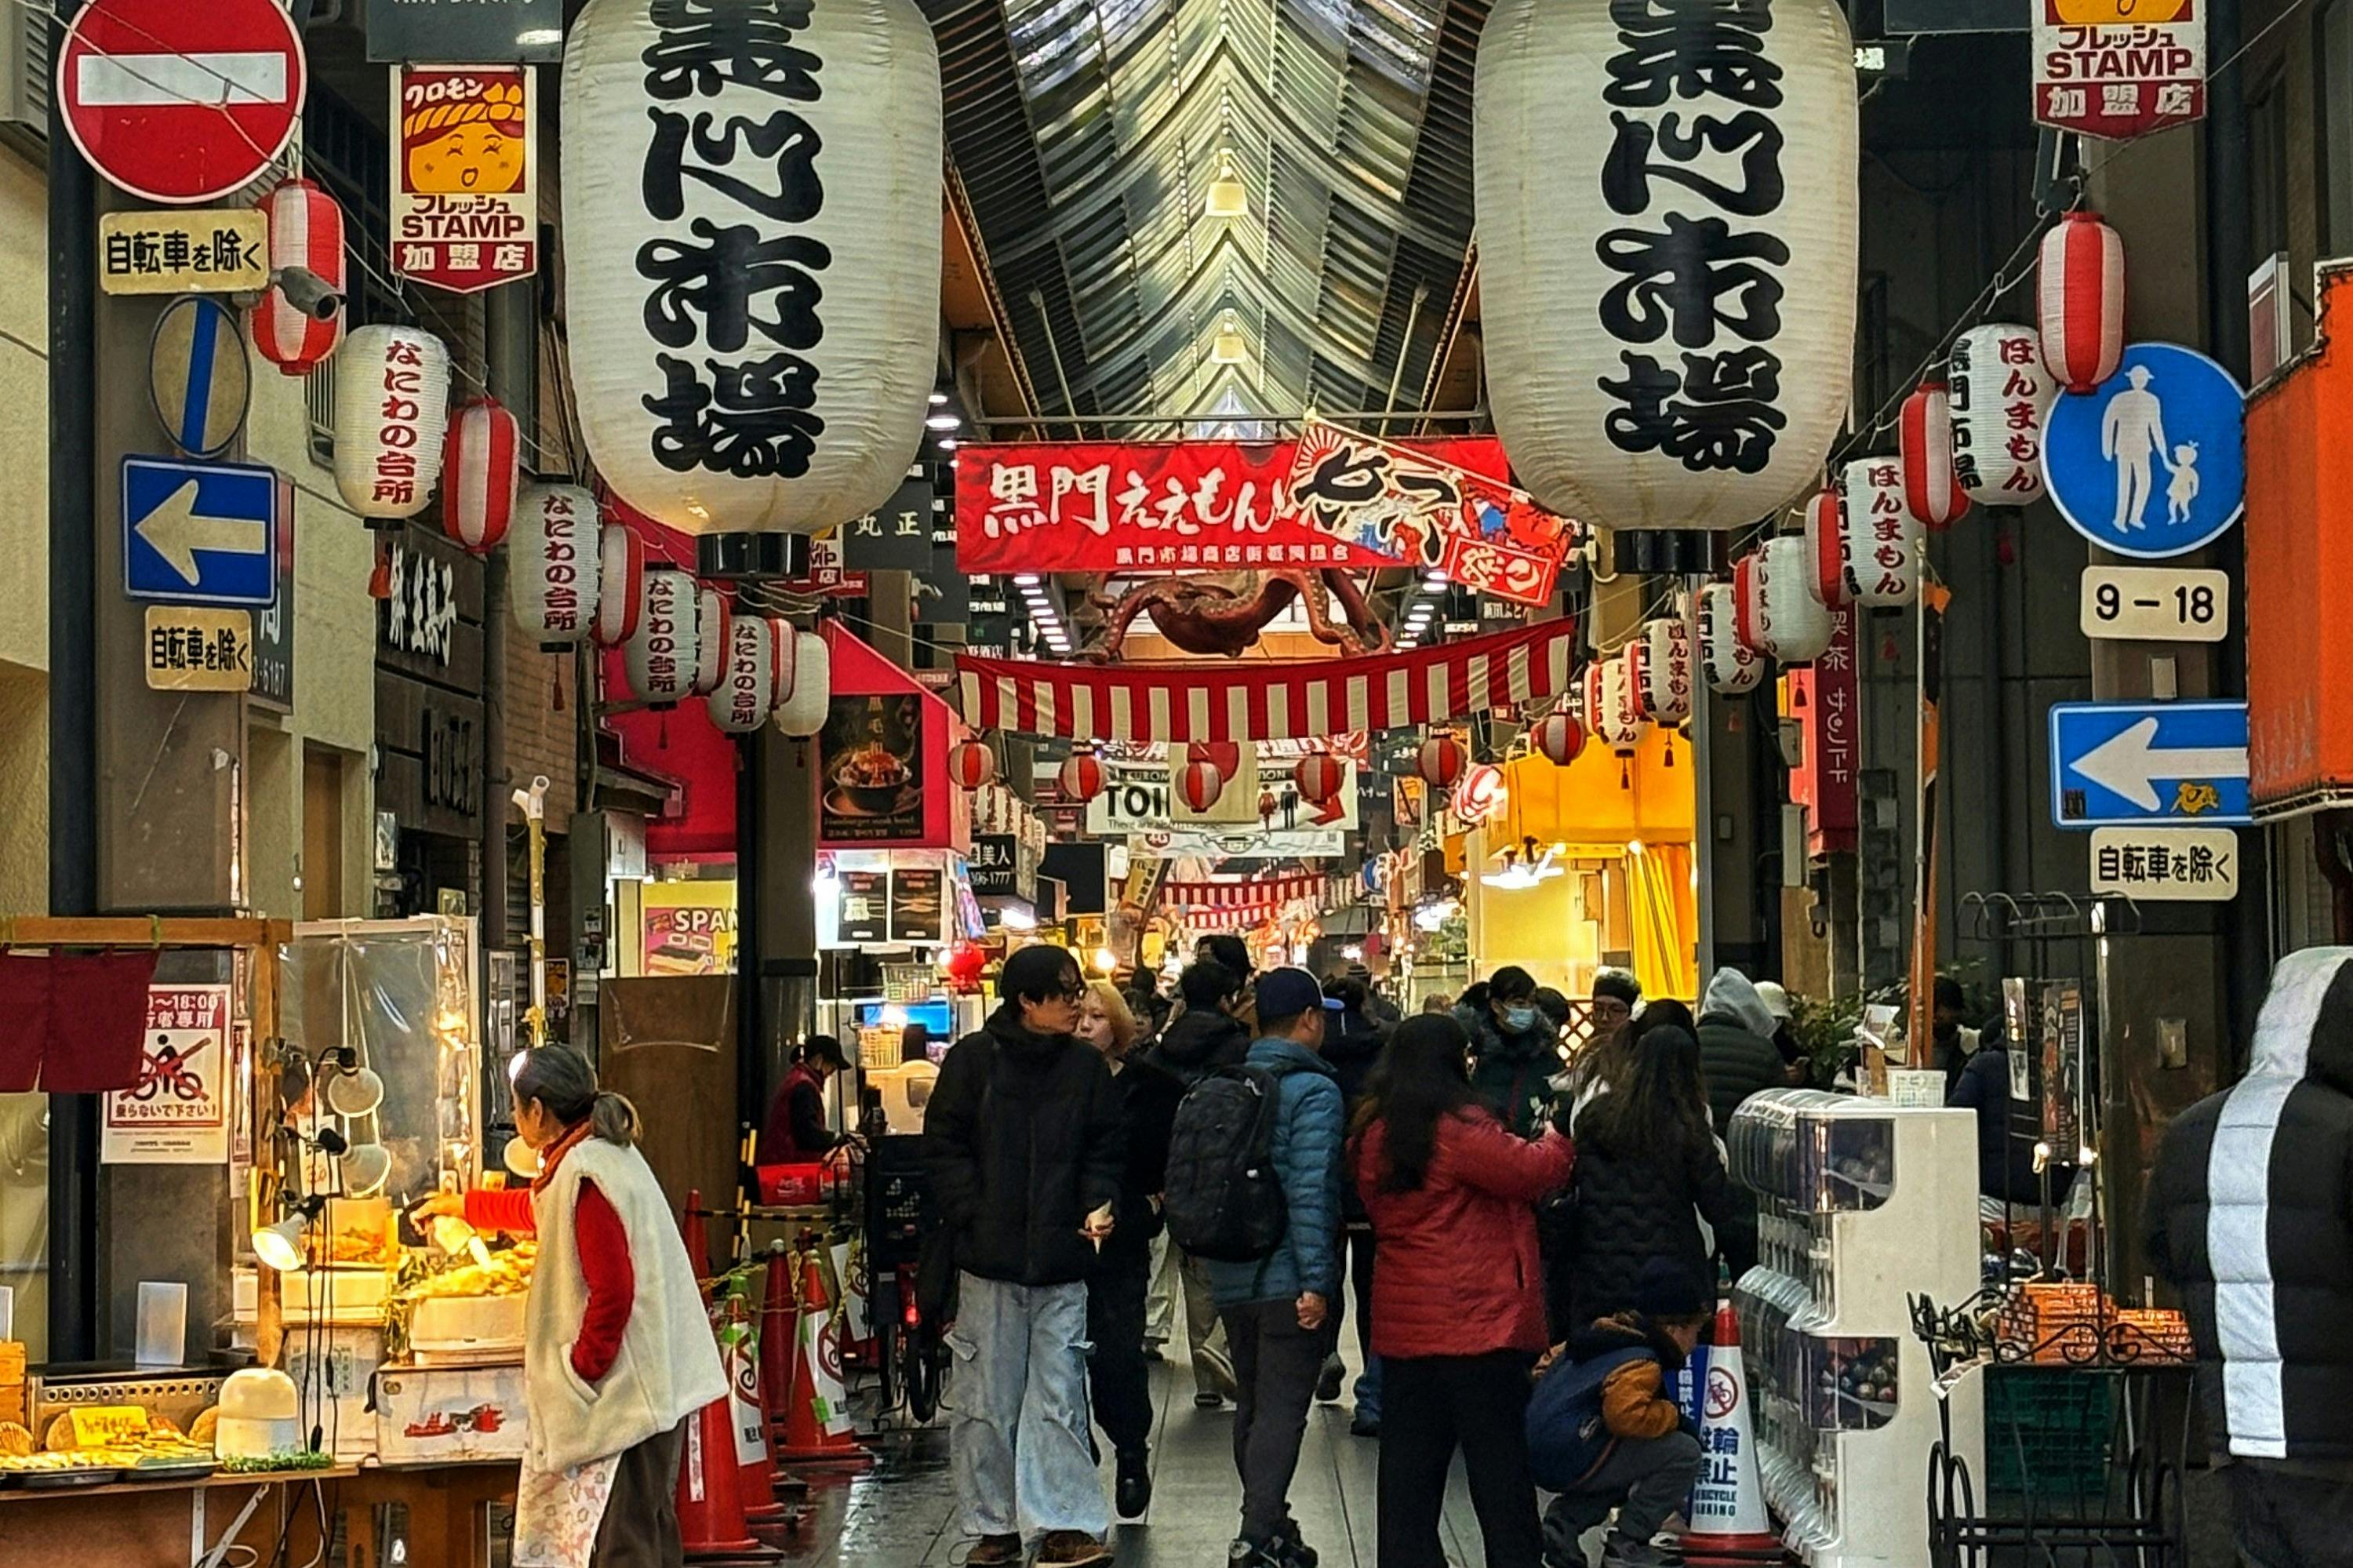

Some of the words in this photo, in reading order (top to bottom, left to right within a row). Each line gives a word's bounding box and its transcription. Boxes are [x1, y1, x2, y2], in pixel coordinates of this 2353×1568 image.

[2059, 25, 2176, 49] フレッシュ
[2046, 49, 2192, 78] STAMP
[405, 77, 484, 104] クロモン
[2048, 83, 2192, 118] 加盟店
[410, 195, 511, 215] フレッシュ
[401, 216, 526, 239] STAMP
[107, 231, 261, 275] 自転車を除く
[401, 244, 526, 271] 加盟店
[371, 340, 423, 505] なにわの台所
[1998, 337, 2040, 493] ほんまもん
[984, 462, 1291, 538] 黒門ええもん
[854, 511, 922, 537] 丸正
[1867, 464, 1907, 595] ほんまもん
[543, 495, 578, 631] なにわの台所
[151, 627, 248, 672] 自転車を除く
[647, 578, 676, 693] なにわの台所
[2098, 845, 2231, 883] 自転車を除く
